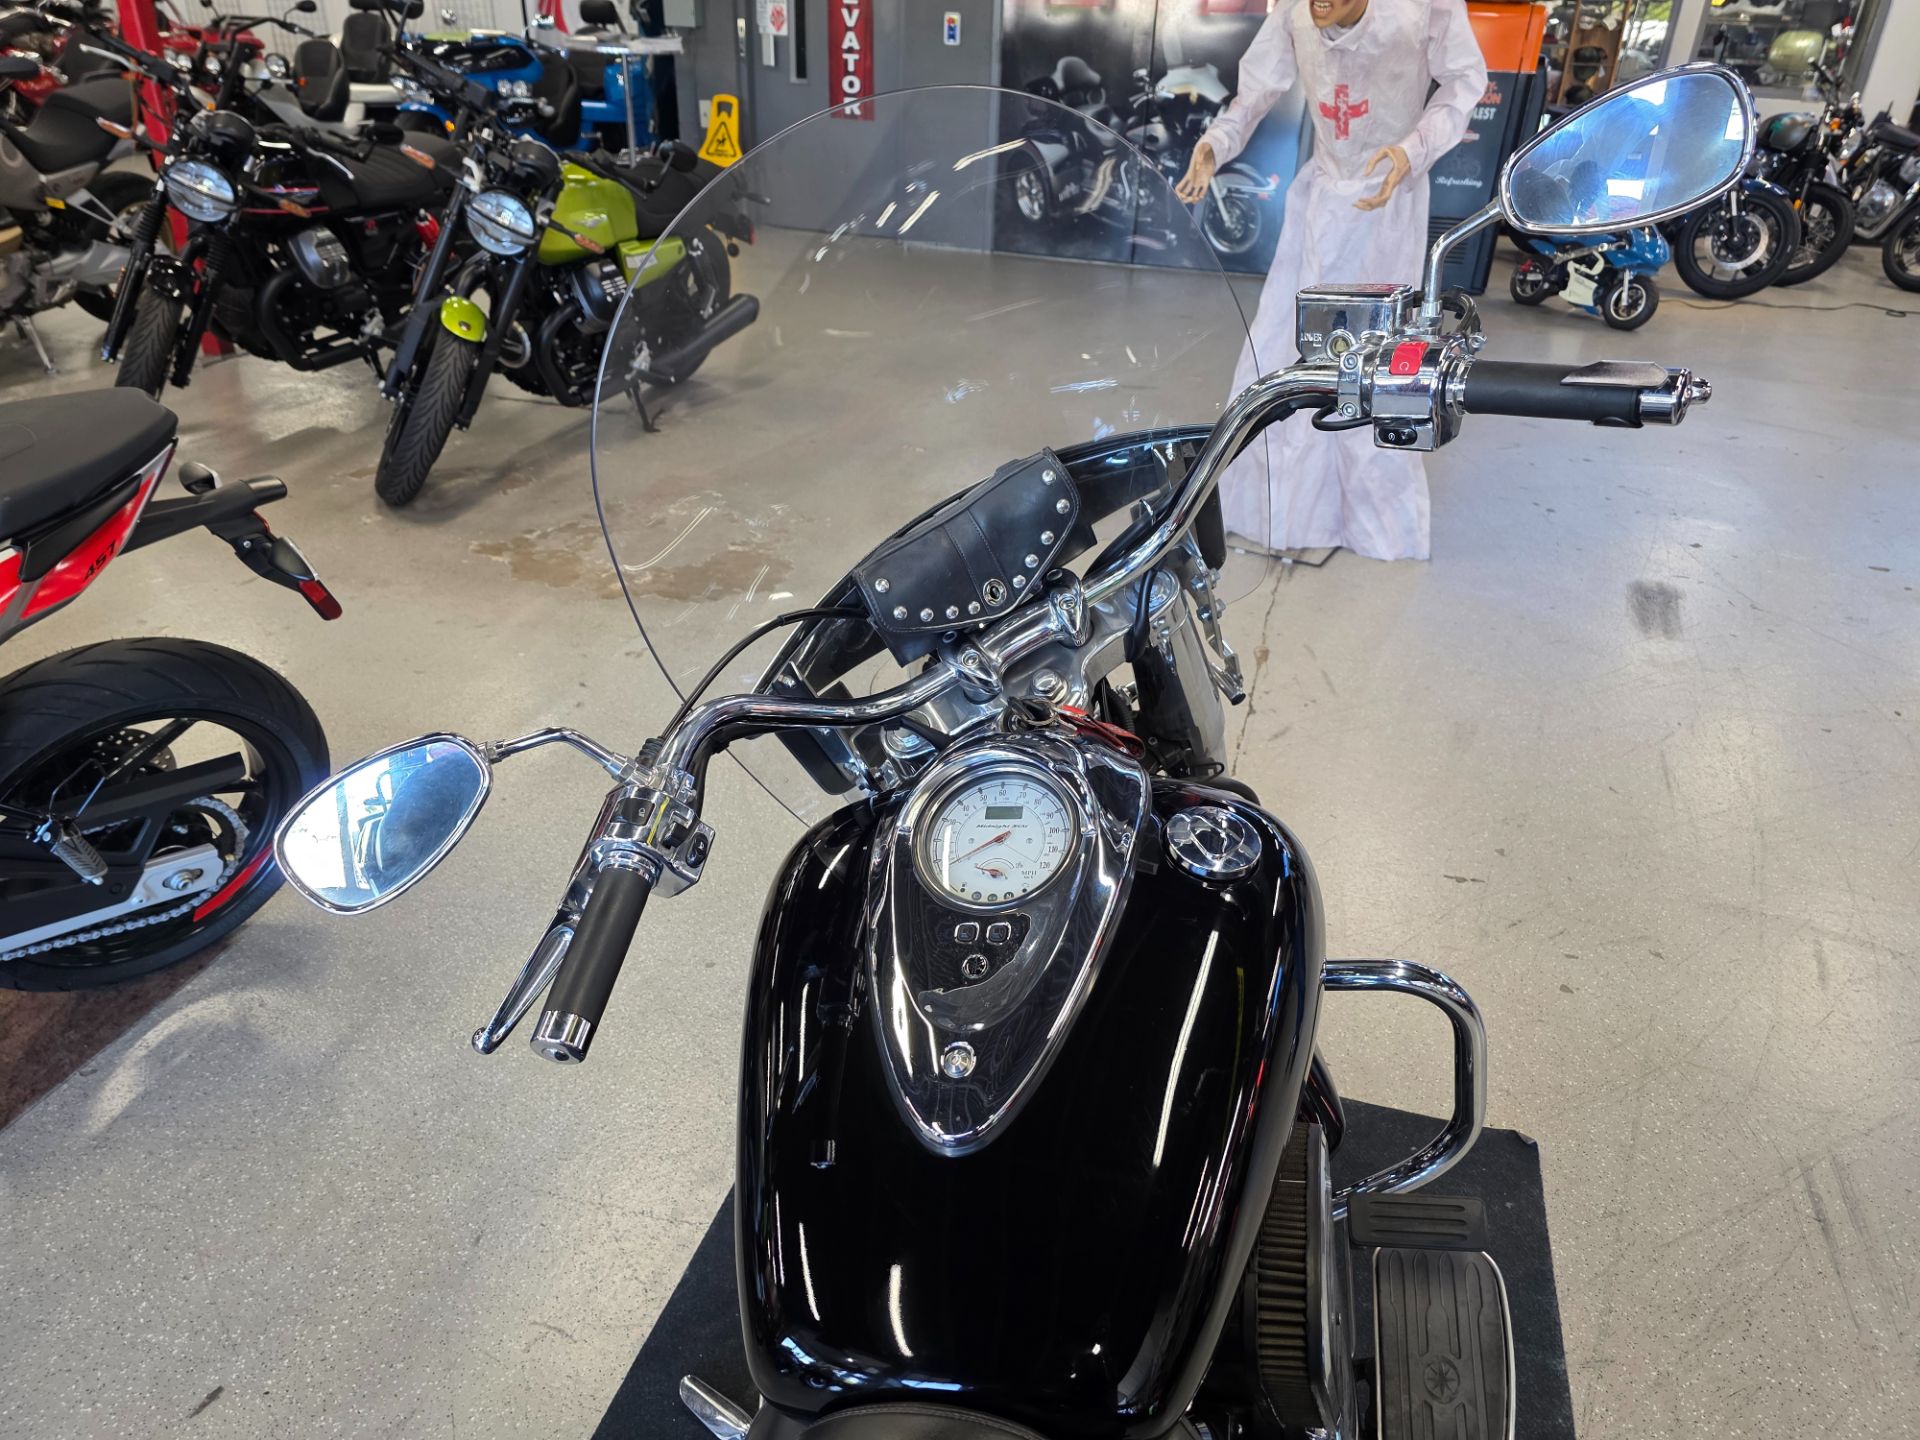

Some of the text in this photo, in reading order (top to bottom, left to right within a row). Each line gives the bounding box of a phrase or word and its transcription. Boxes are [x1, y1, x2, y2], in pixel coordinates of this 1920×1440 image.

[841, 0, 861, 114] VATOR
[1434, 175, 1483, 188] Refreshing
[83, 540, 116, 583] 457
[998, 789, 1007, 797] 60
[980, 794, 988, 802] 50
[1049, 826, 1060, 834] 100
[1048, 845, 1059, 853] 110
